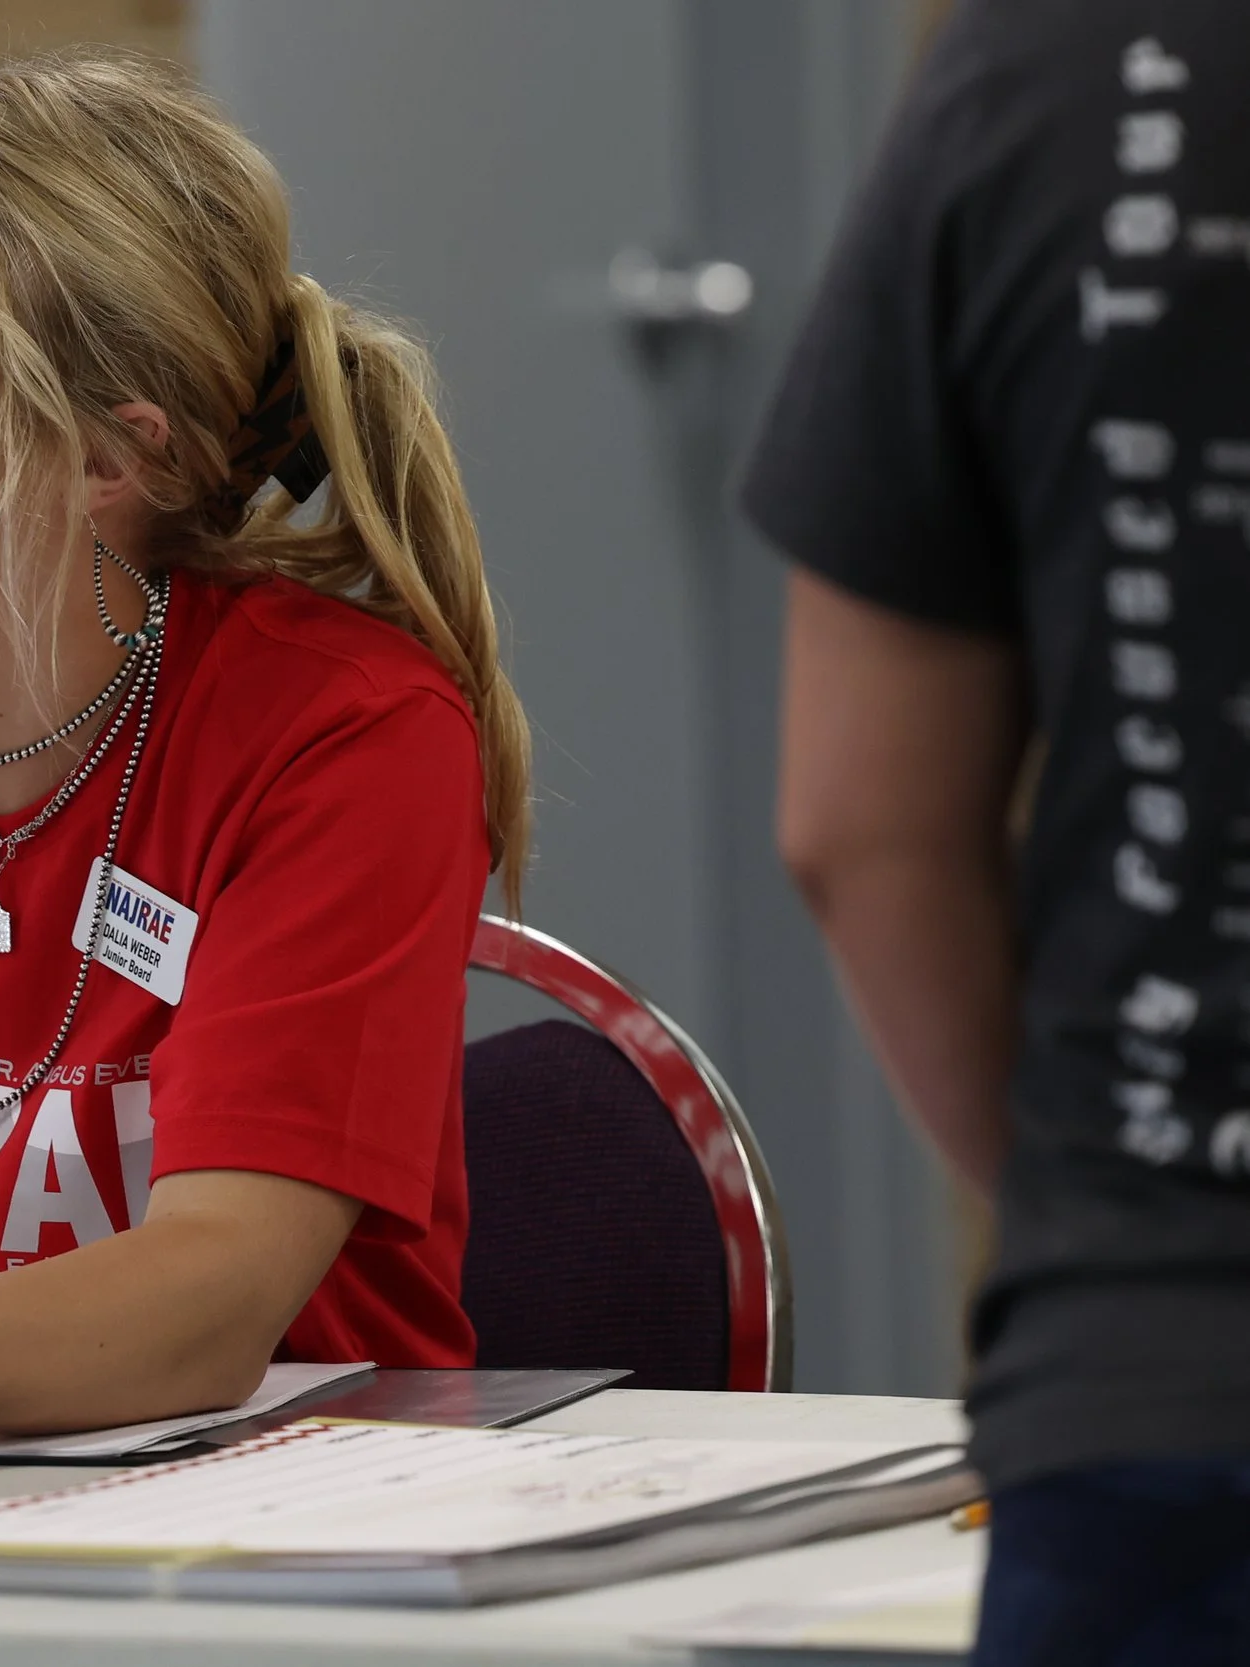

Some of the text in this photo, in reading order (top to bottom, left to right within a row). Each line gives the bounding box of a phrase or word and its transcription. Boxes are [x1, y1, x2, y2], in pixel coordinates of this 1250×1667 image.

[1079, 36, 1190, 345] Tour
[1089, 416, 1187, 913] Focused
[102, 922, 162, 969] DALIA WEBER
[104, 881, 176, 946] NAJRAE
[102, 944, 153, 983] Junior Board
